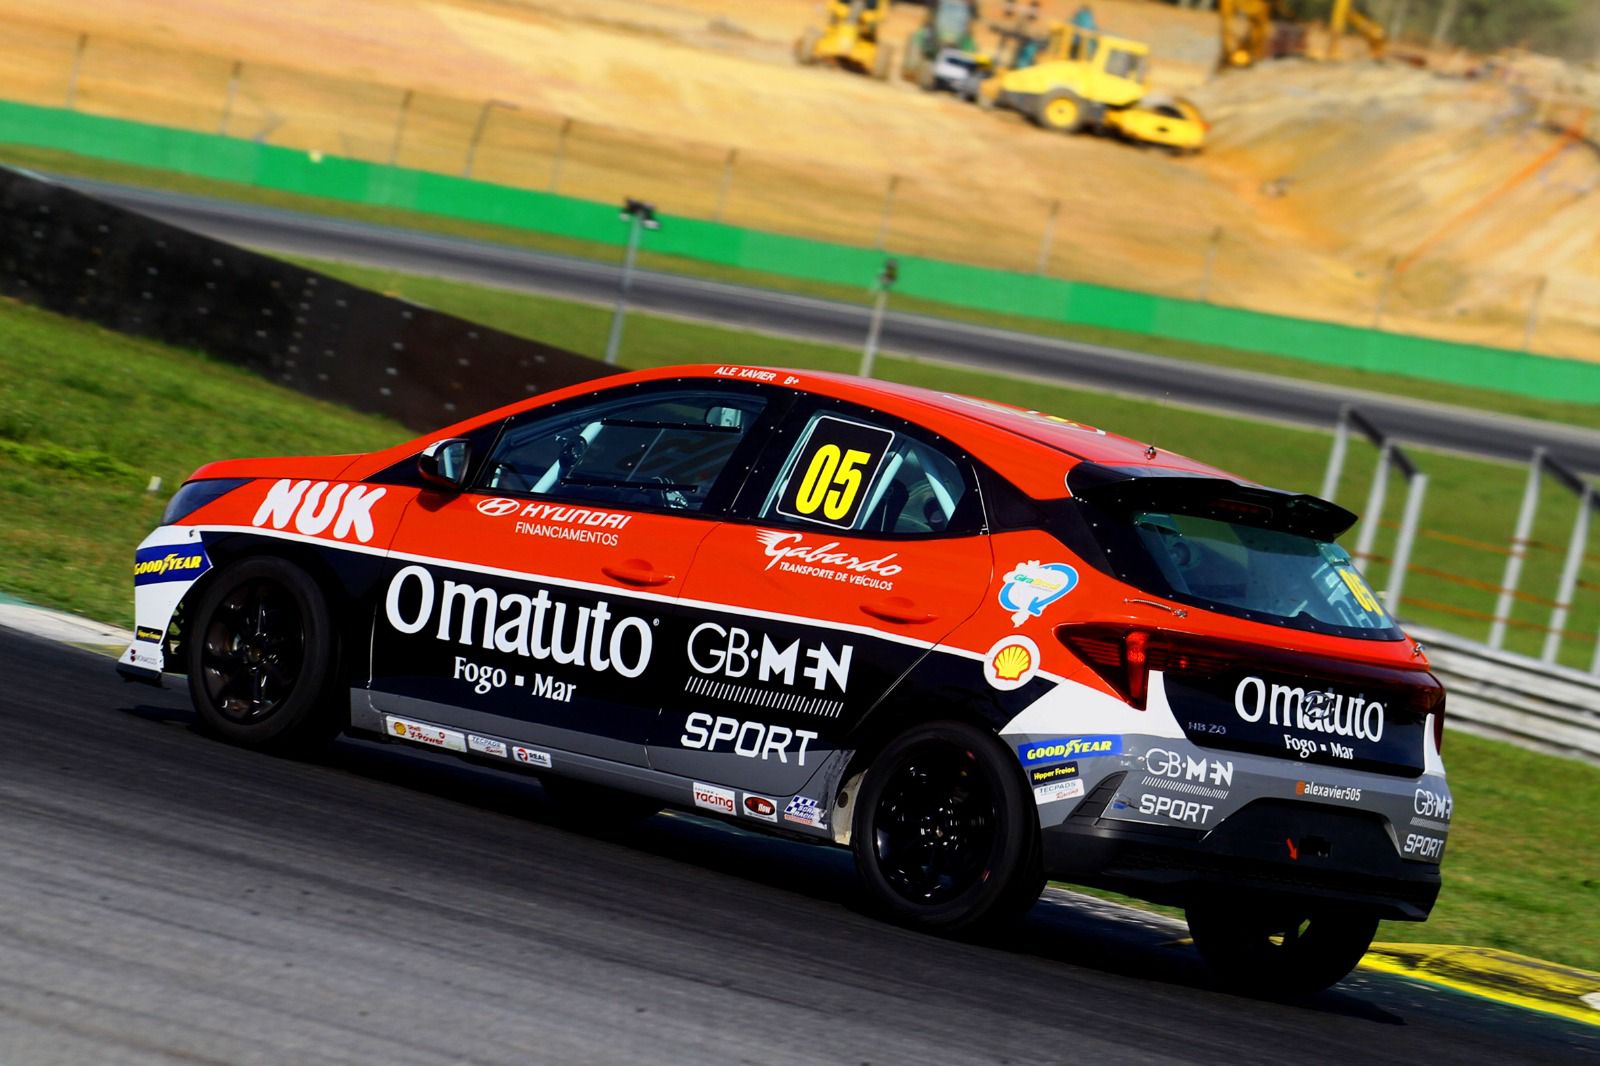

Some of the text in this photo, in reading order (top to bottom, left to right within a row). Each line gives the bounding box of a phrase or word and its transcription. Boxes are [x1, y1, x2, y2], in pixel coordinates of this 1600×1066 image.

[714, 366, 738, 376] ALE
[738, 368, 776, 381] XAVIER
[795, 444, 871, 521] 05
[252, 478, 387, 543] NUK
[520, 503, 632, 529] HYUNDAI
[515, 521, 619, 546] FINANCIAMENTOS
[756, 529, 902, 576] Gabardo
[779, 561, 893, 591] TRANSPORTE DE VEÍCULOS
[453, 656, 576, 703] Fogo Mar
[680, 712, 818, 766] SPORT
[1026, 739, 1112, 760] GOODYEAR
[1284, 734, 1353, 759] Fogo Mar
[1034, 767, 1076, 780] Hipper Freios
[1040, 782, 1076, 793] TECPADS
[1304, 781, 1361, 802] alexavier505
[696, 791, 733, 811] racing
[1139, 794, 1214, 824] SPORT
[1404, 833, 1444, 859] SPORT
